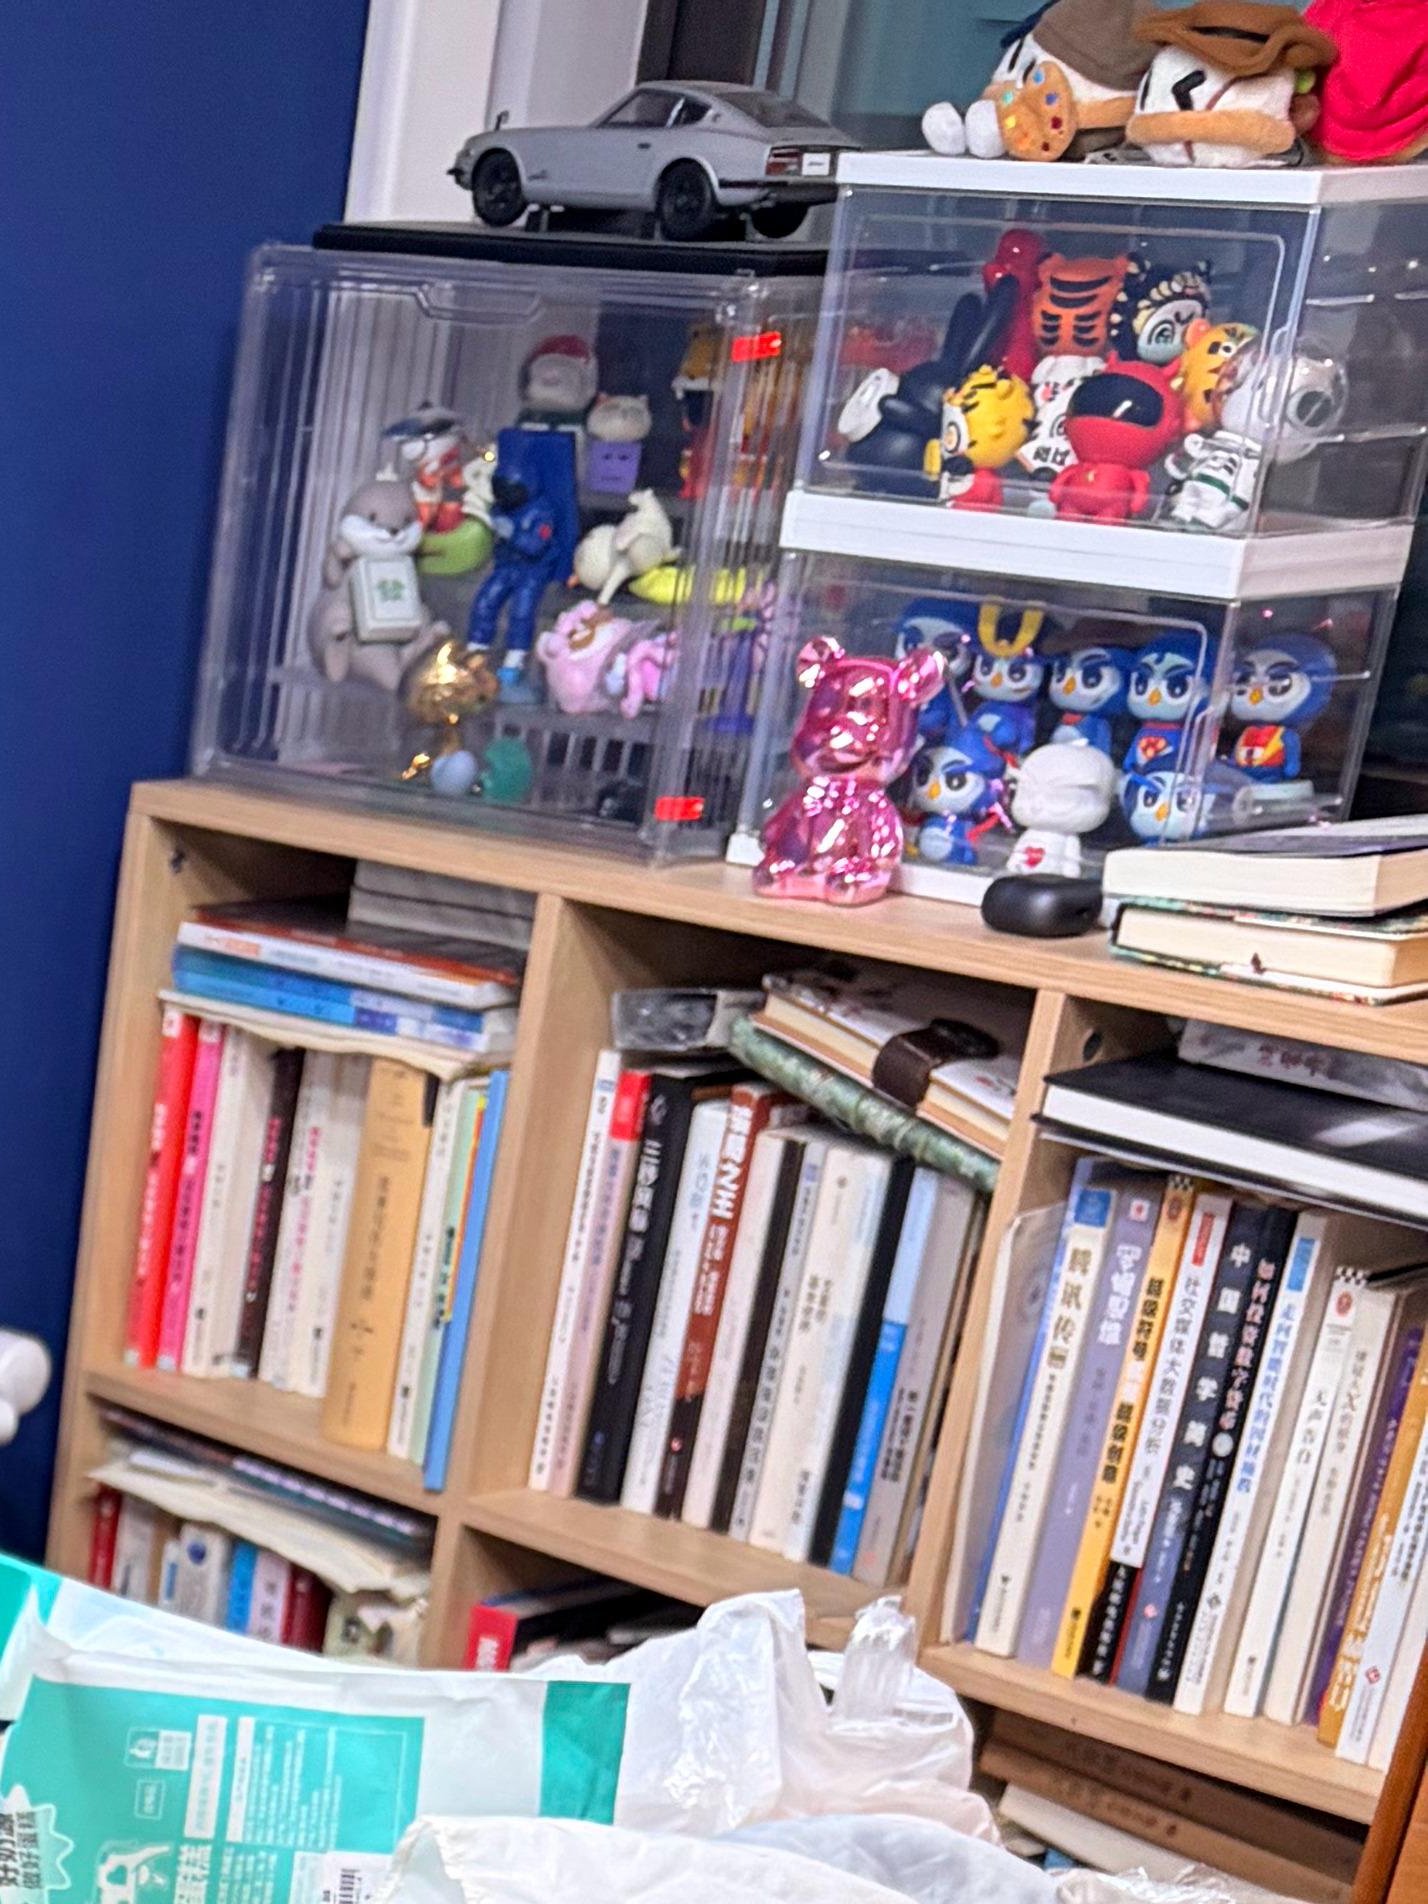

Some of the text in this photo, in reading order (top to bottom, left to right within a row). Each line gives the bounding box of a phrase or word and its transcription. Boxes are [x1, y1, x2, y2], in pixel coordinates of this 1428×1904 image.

[1173, 1241, 1251, 1490] 中国哲学简史
